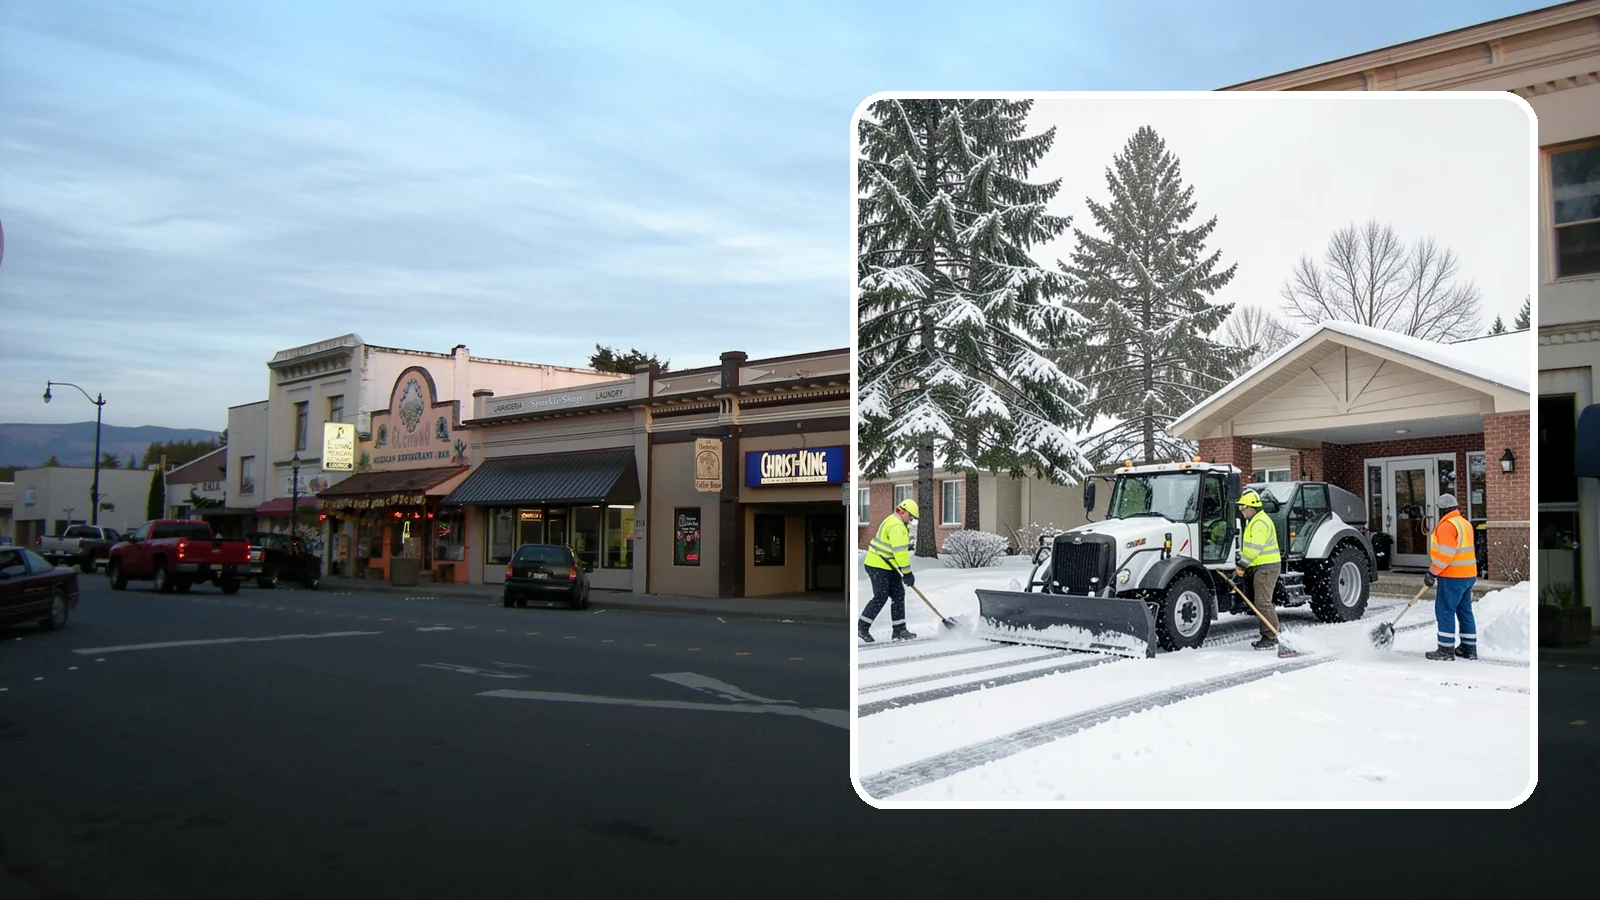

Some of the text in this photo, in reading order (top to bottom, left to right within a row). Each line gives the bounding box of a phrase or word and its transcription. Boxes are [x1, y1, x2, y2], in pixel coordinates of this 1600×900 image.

[562, 395, 582, 405] Shop
[595, 389, 623, 400] LAUNDRY
[493, 402, 522, 412] LAVANDERIA
[374, 455, 396, 464] MEXICAN
[397, 451, 433, 462] RESTAURANT
[438, 450, 450, 459] BAR
[761, 450, 827, 478] CHRIST KING
